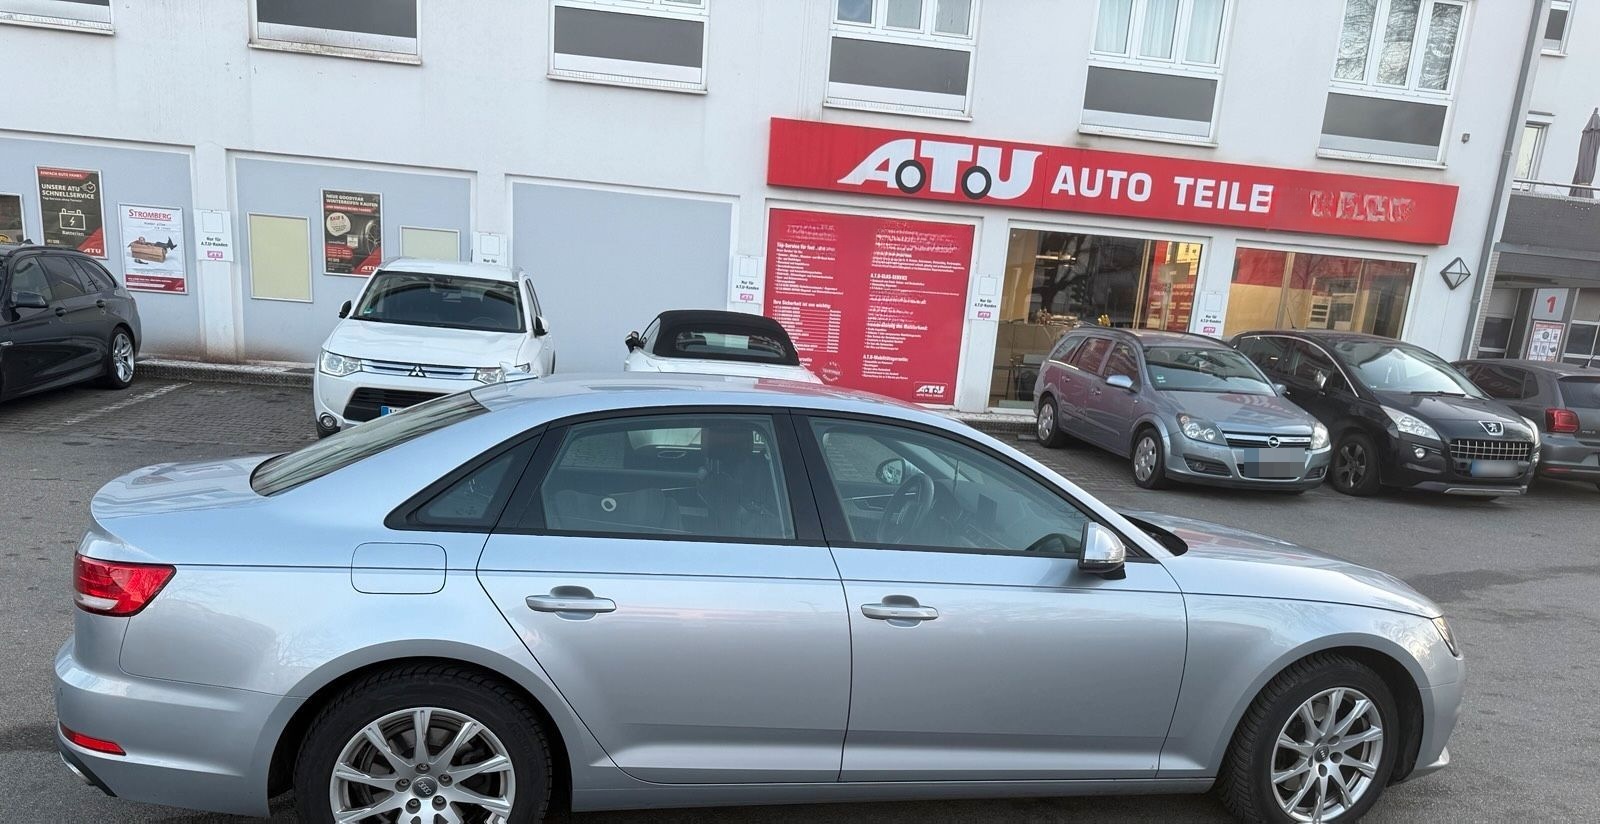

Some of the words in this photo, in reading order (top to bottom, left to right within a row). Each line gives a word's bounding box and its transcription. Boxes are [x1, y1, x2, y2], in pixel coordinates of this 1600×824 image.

[41, 190, 95, 200] SCHNELLSERVICE
[1050, 165, 1153, 202] AUTO
[1174, 176, 1274, 213] TEILE
[128, 208, 172, 219] STROMBERG
[1546, 296, 1557, 313] 1
